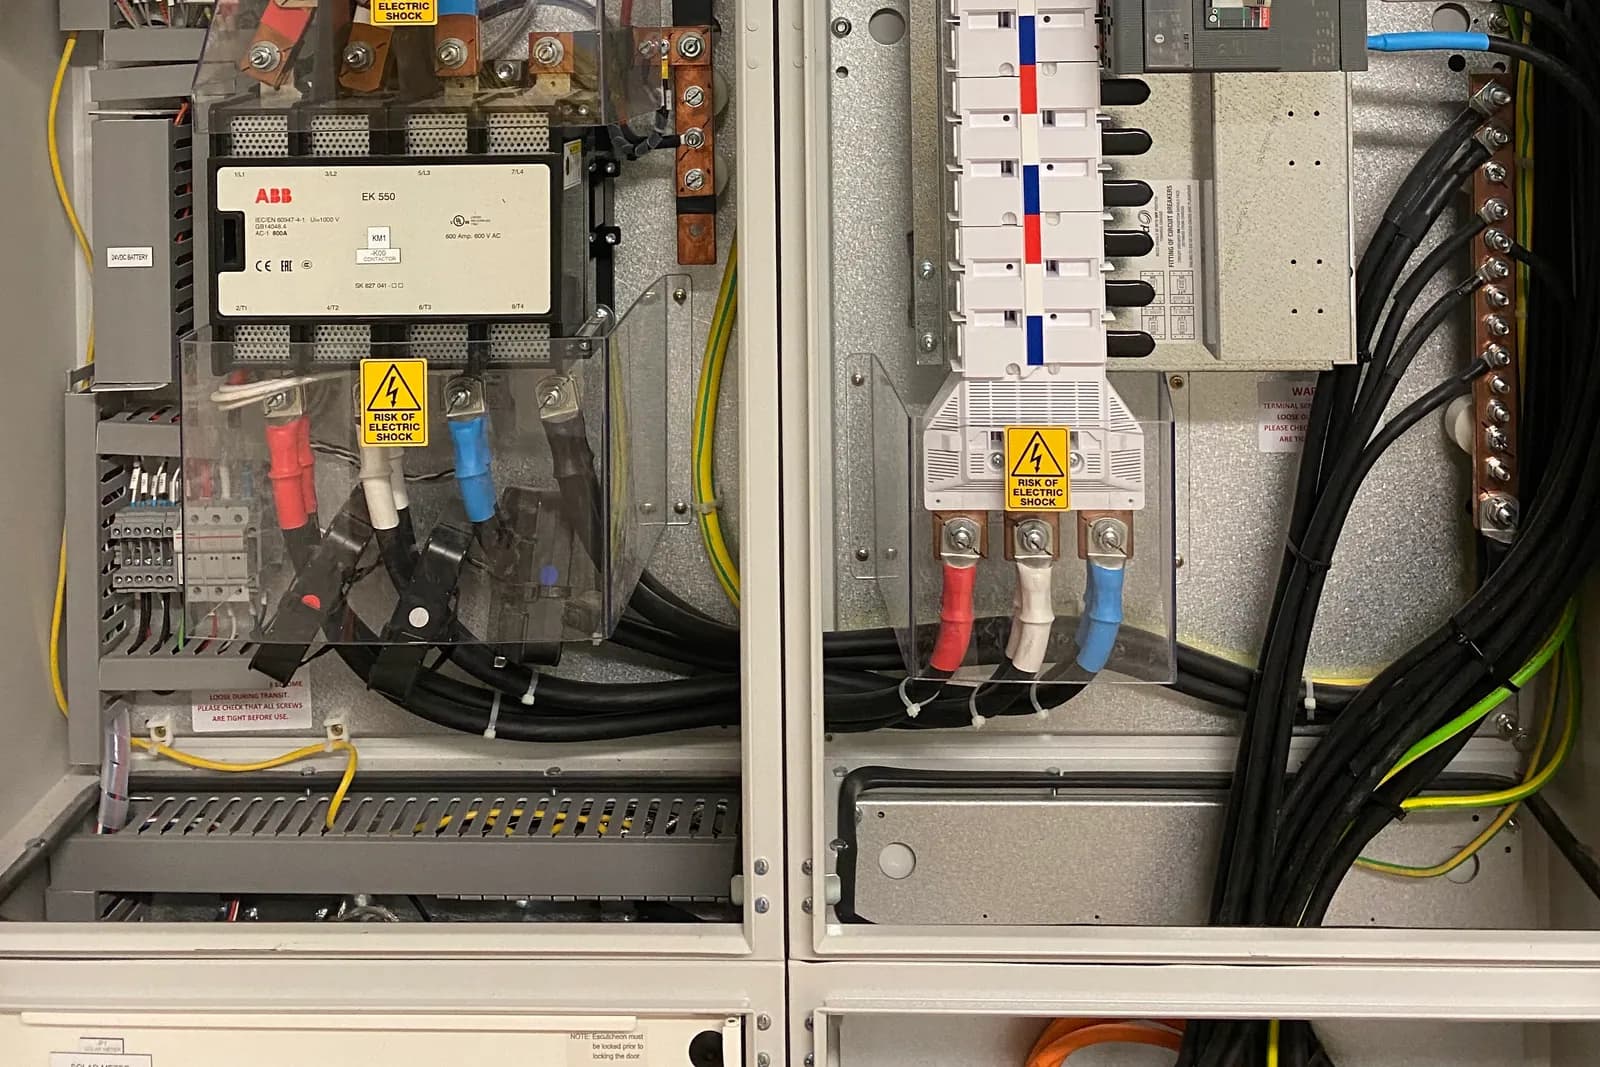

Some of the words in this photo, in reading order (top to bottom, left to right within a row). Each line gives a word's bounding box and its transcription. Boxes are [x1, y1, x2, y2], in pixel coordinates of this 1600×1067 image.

[378, 2, 430, 10] ELECTRIC
[386, 12, 422, 20] SHOCK
[255, 188, 293, 204] ABB
[362, 192, 376, 201] EK
[378, 192, 396, 201] 550
[374, 413, 398, 421] RISK
[401, 413, 415, 421] OF
[369, 423, 420, 431] ELECTRIC
[376, 433, 413, 441] SHOCK
[1018, 479, 1041, 487] RISK
[1045, 479, 1058, 487] OF
[1013, 488, 1063, 497] ELECTRIC
[1020, 498, 1056, 506] SHOCK
[197, 704, 221, 712] PLEASE
[623, 1043, 636, 1051] prior
